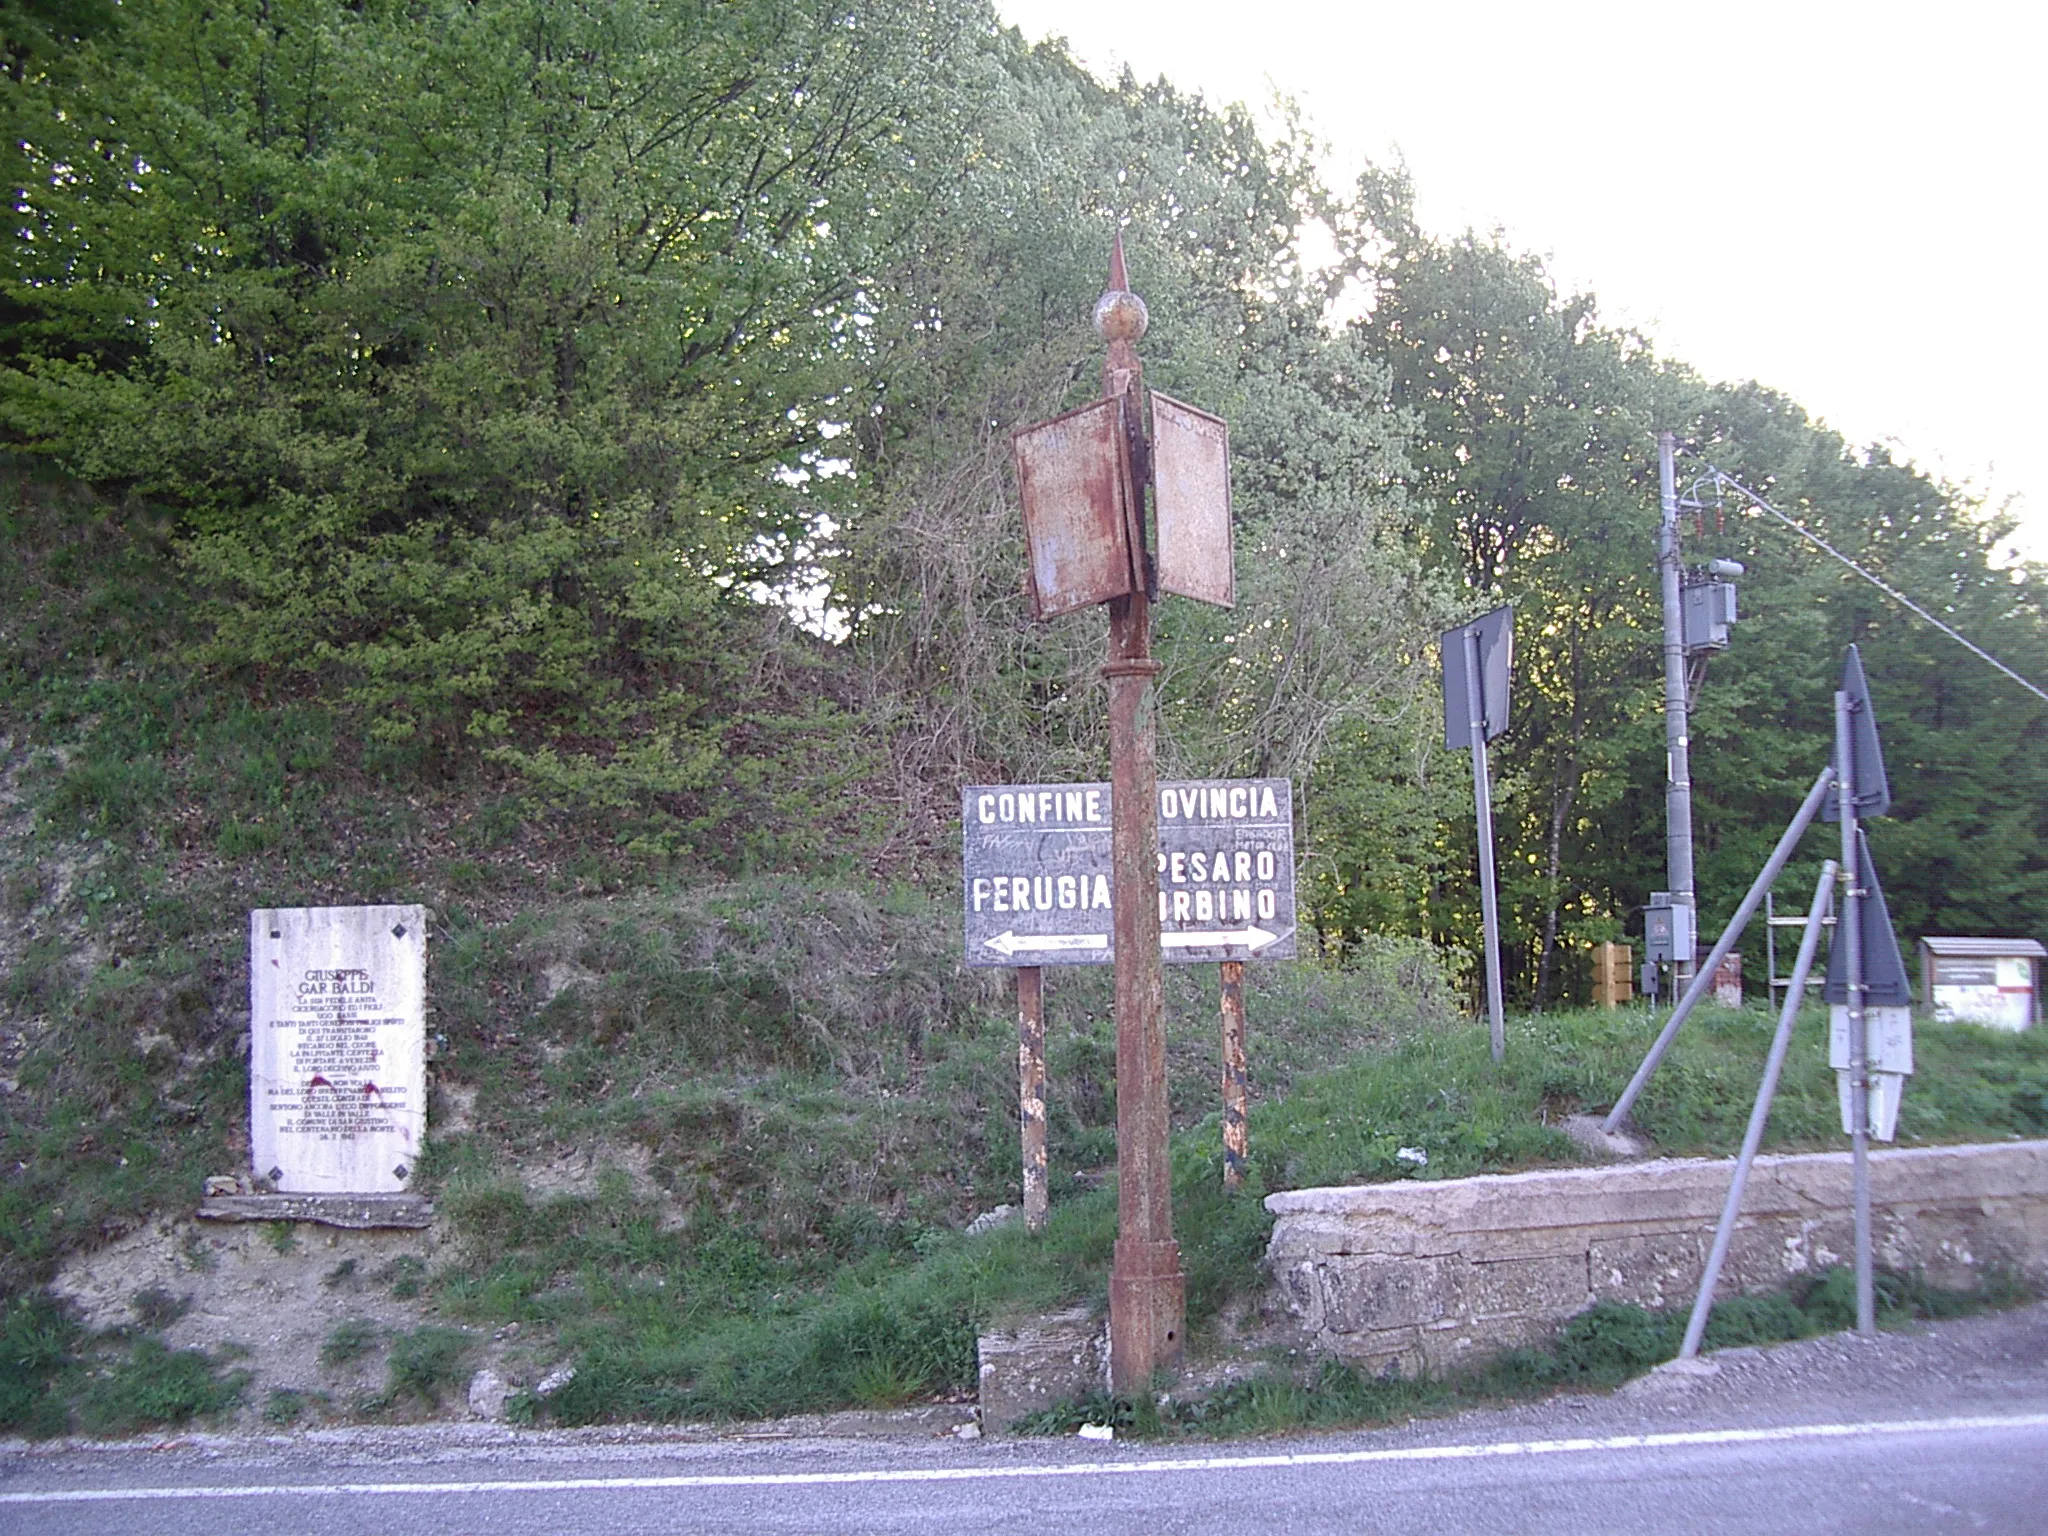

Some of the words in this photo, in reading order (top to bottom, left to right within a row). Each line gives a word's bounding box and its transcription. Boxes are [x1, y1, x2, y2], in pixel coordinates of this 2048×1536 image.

[978, 790, 1101, 823] CONFINE
[1161, 787, 1278, 819] OVINCIA
[973, 874, 1112, 911] PERUGIA
[305, 969, 369, 982] GIUSEPPE
[299, 981, 374, 994] GARBALDI
[276, 1020, 297, 1028] TANTI
[325, 1034, 352, 1042] LUGLIO
[351, 1041, 377, 1049] CUORE
[302, 1049, 345, 1057] PALPITANTE
[346, 1048, 384, 1057] CERTEZZA
[305, 1057, 336, 1065] PORTARE
[303, 1065, 322, 1073] LORO
[281, 1088, 295, 1096] DEL
[269, 1103, 303, 1111] SENTONO
[314, 1110, 336, 1118] VALLE
[296, 1125, 343, 1133] CENTENARIO
[369, 1125, 396, 1133] MORTE
